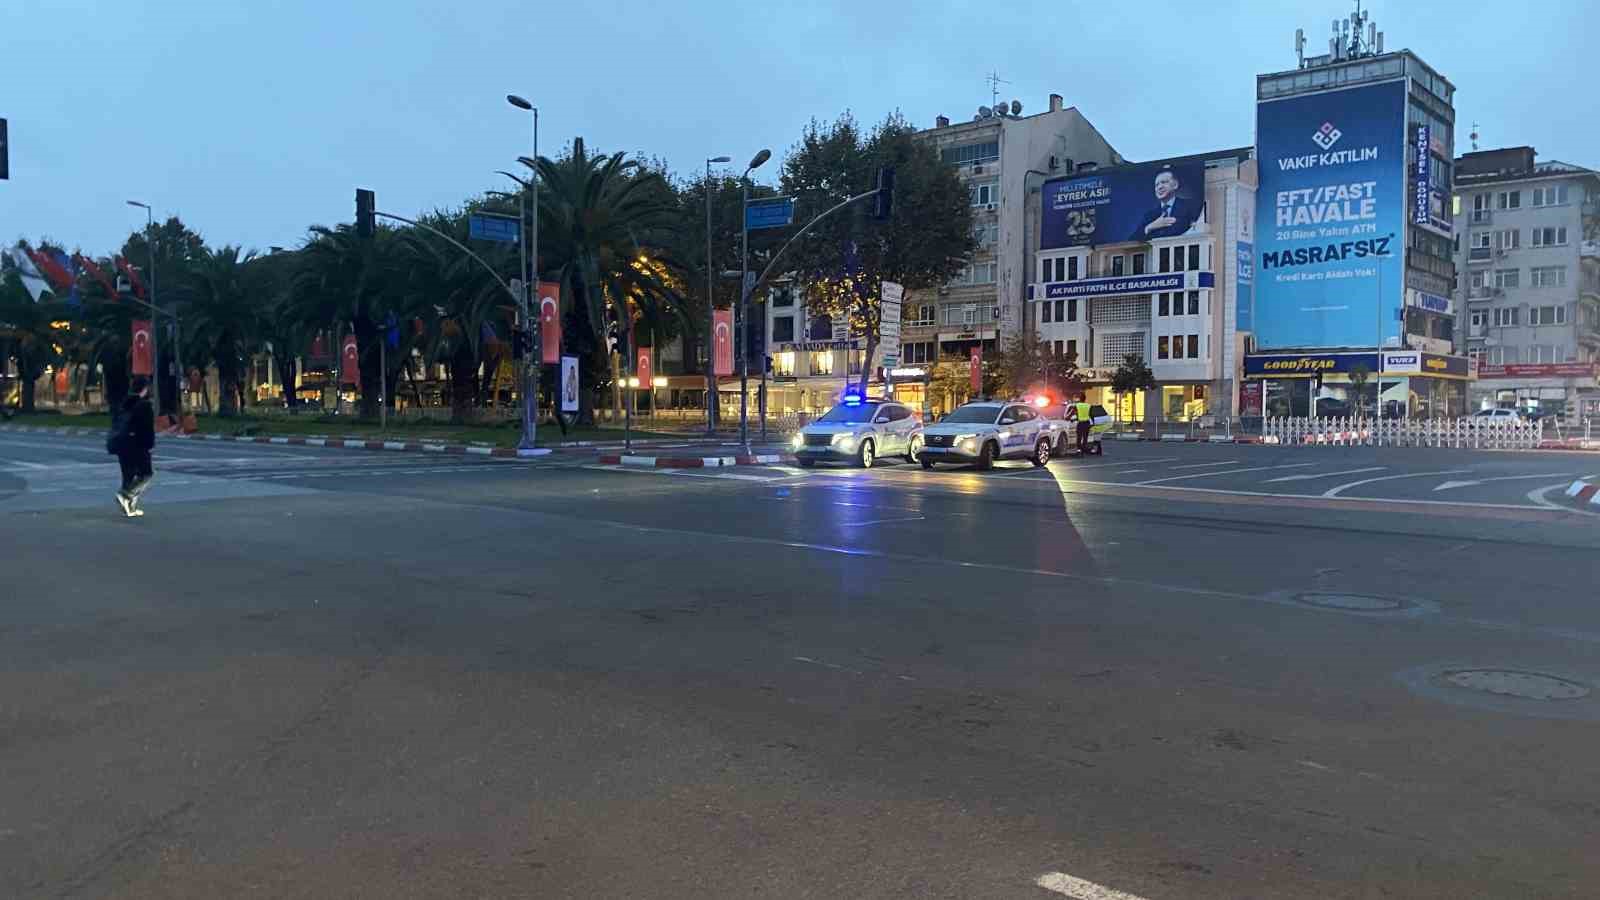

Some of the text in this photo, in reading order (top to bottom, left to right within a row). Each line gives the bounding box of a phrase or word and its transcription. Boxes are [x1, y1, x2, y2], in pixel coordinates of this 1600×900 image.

[1278, 147, 1378, 170] VAKIF KATILIM
[1276, 182, 1377, 207] EFT/FAST
[1276, 198, 1377, 226] HAVALE
[1276, 231, 1290, 241] 20
[1352, 223, 1377, 234] ATM
[1264, 358, 1335, 369] GOODYEAR
